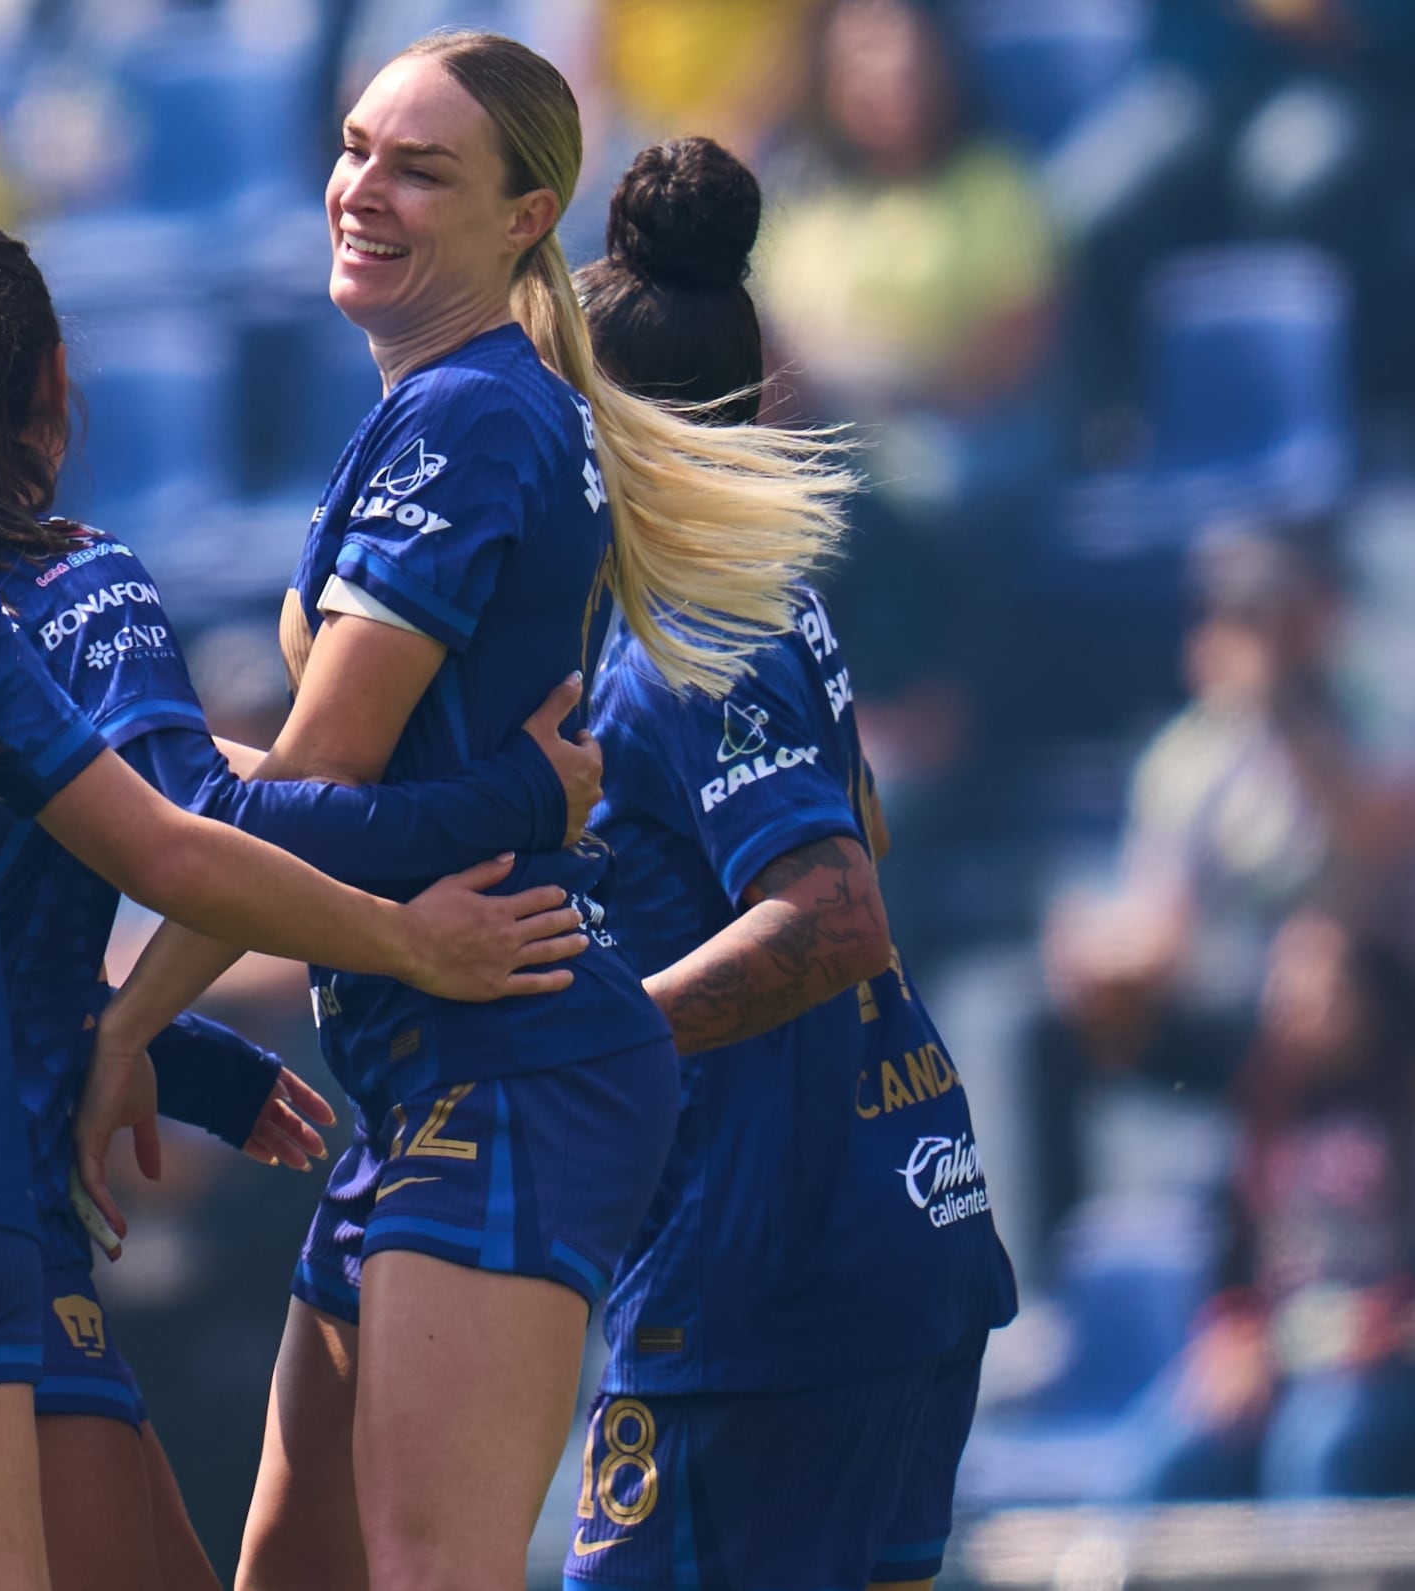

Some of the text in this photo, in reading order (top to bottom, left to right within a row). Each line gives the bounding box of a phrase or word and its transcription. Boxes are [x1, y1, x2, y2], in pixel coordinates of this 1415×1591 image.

[38, 581, 161, 652] BONAFON
[113, 624, 167, 652] GNP
[699, 746, 819, 813] RALOY
[577, 1399, 659, 1526] 18
